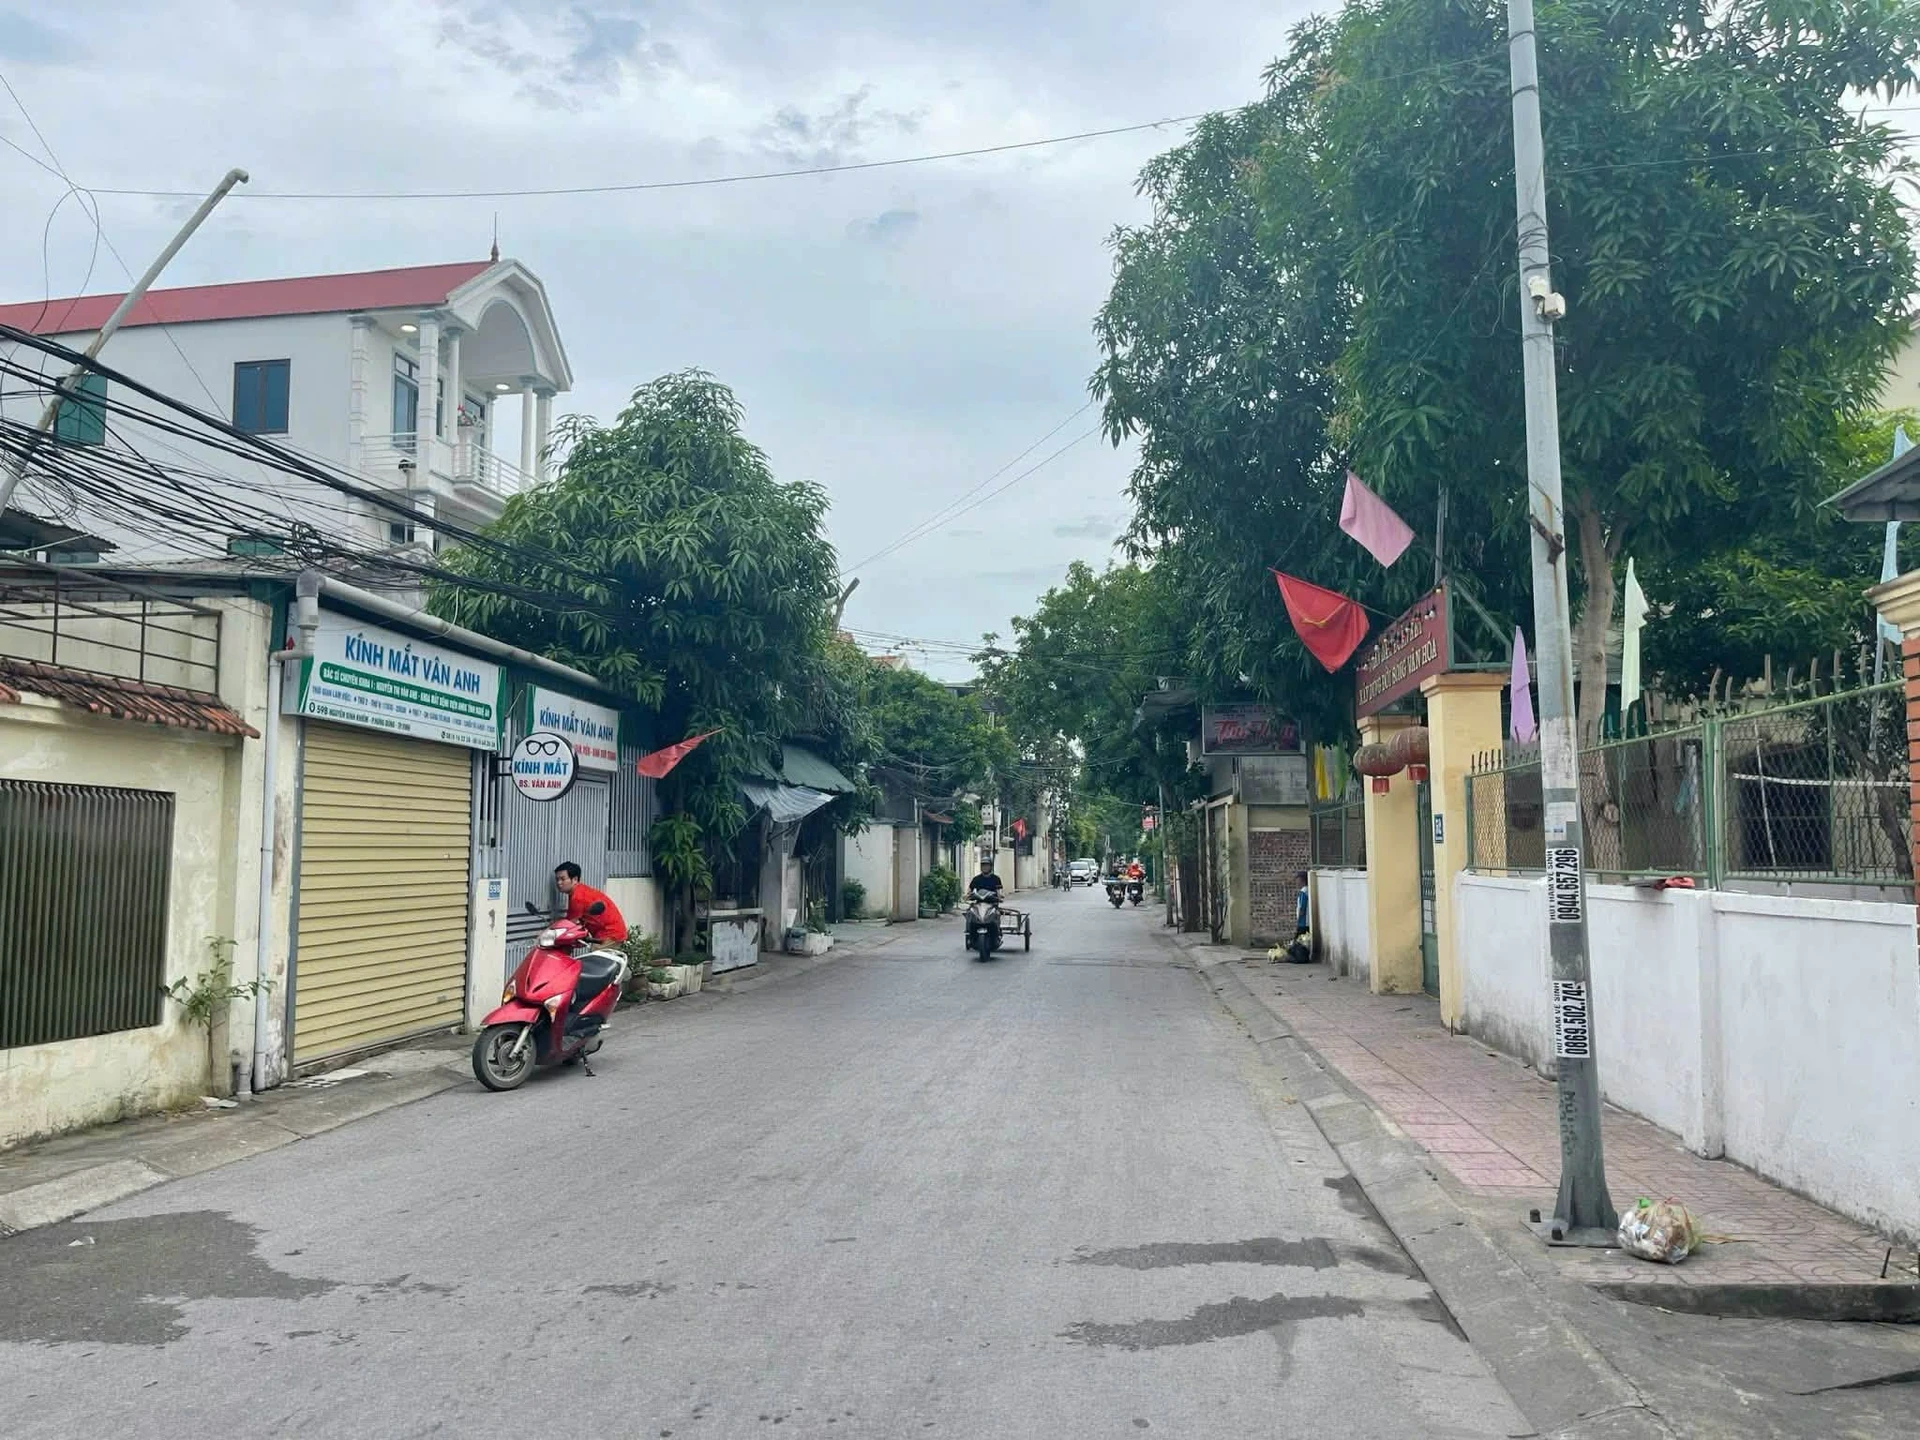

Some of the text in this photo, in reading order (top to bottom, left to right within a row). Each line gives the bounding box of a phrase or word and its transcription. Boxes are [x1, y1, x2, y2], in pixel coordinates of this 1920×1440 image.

[345, 632, 480, 695] KÍNH MẮT VÂN ANH
[540, 706, 614, 743] KÍNH MẮT VÂN ANH
[514, 757, 568, 776] KÍNH MẮT
[531, 778, 546, 789] VÂN
[547, 780, 561, 789] ANH
[1555, 849, 1580, 920] 0944.657.296
